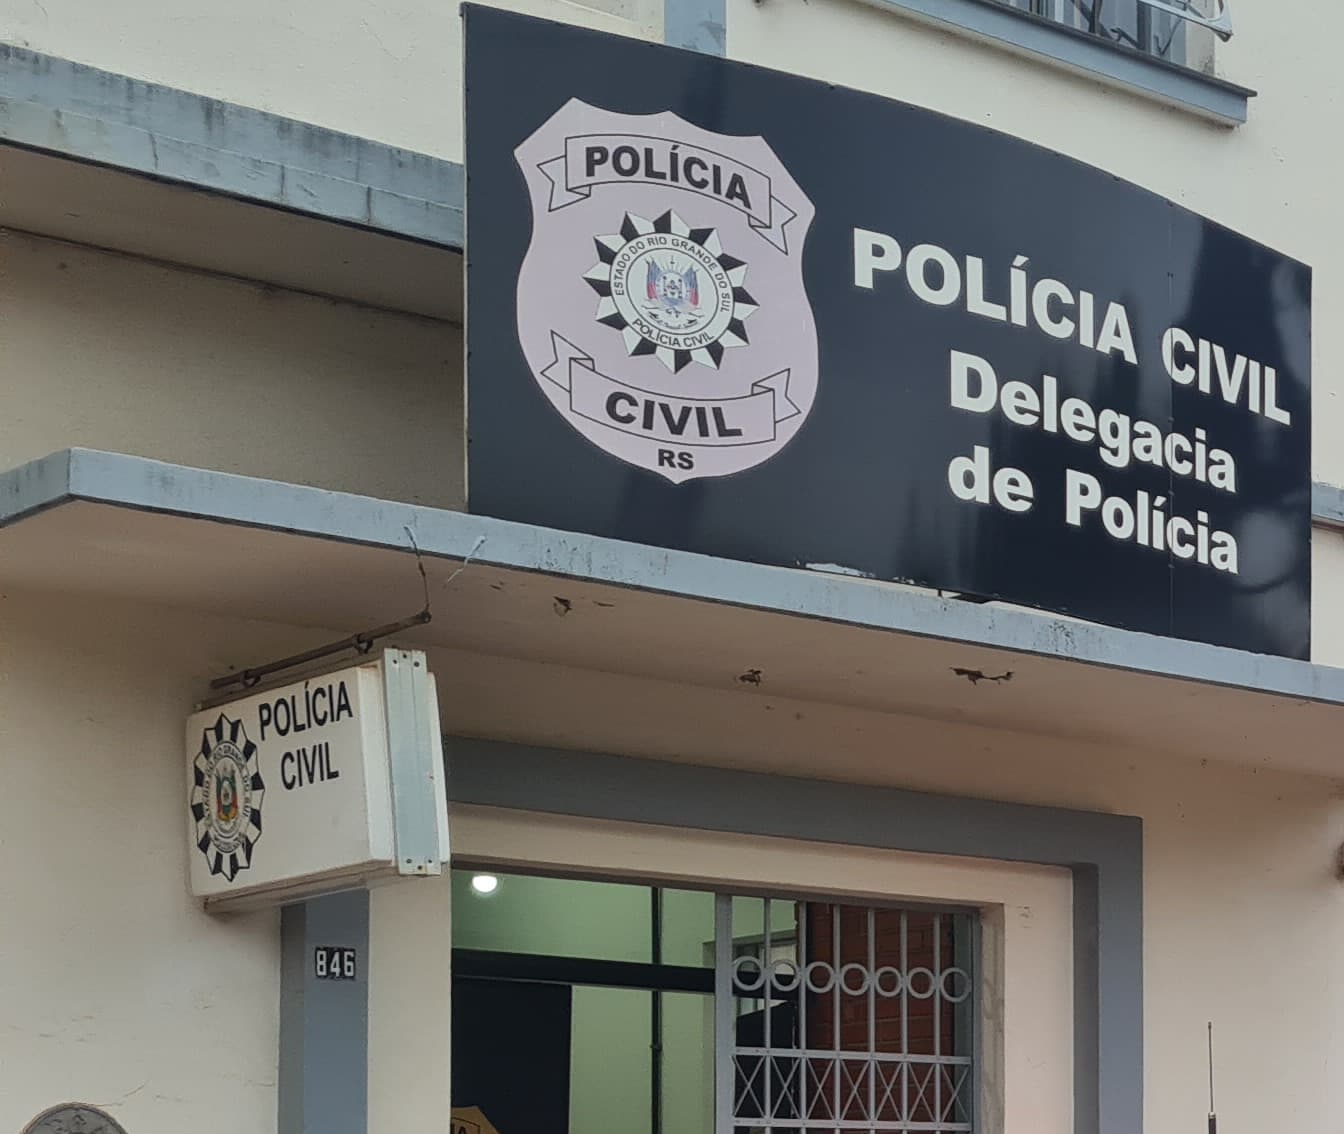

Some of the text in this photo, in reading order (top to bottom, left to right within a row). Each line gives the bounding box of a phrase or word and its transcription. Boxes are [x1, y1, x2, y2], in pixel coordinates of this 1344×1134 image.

[584, 143, 752, 211] POLÍCIA
[616, 236, 731, 313] ESTADO DO RIO GRANDE DO SUL
[683, 331, 715, 348] CIVIL
[853, 227, 1292, 427] POLÍCIA CIVIL
[605, 391, 742, 438] CIVIL
[950, 350, 1236, 494] Delegacia
[658, 448, 694, 472] RS
[948, 446, 1239, 576] de Polícia
[258, 680, 353, 741] POLÍCIA
[281, 742, 339, 790] CIVIL
[316, 950, 354, 977] 846
